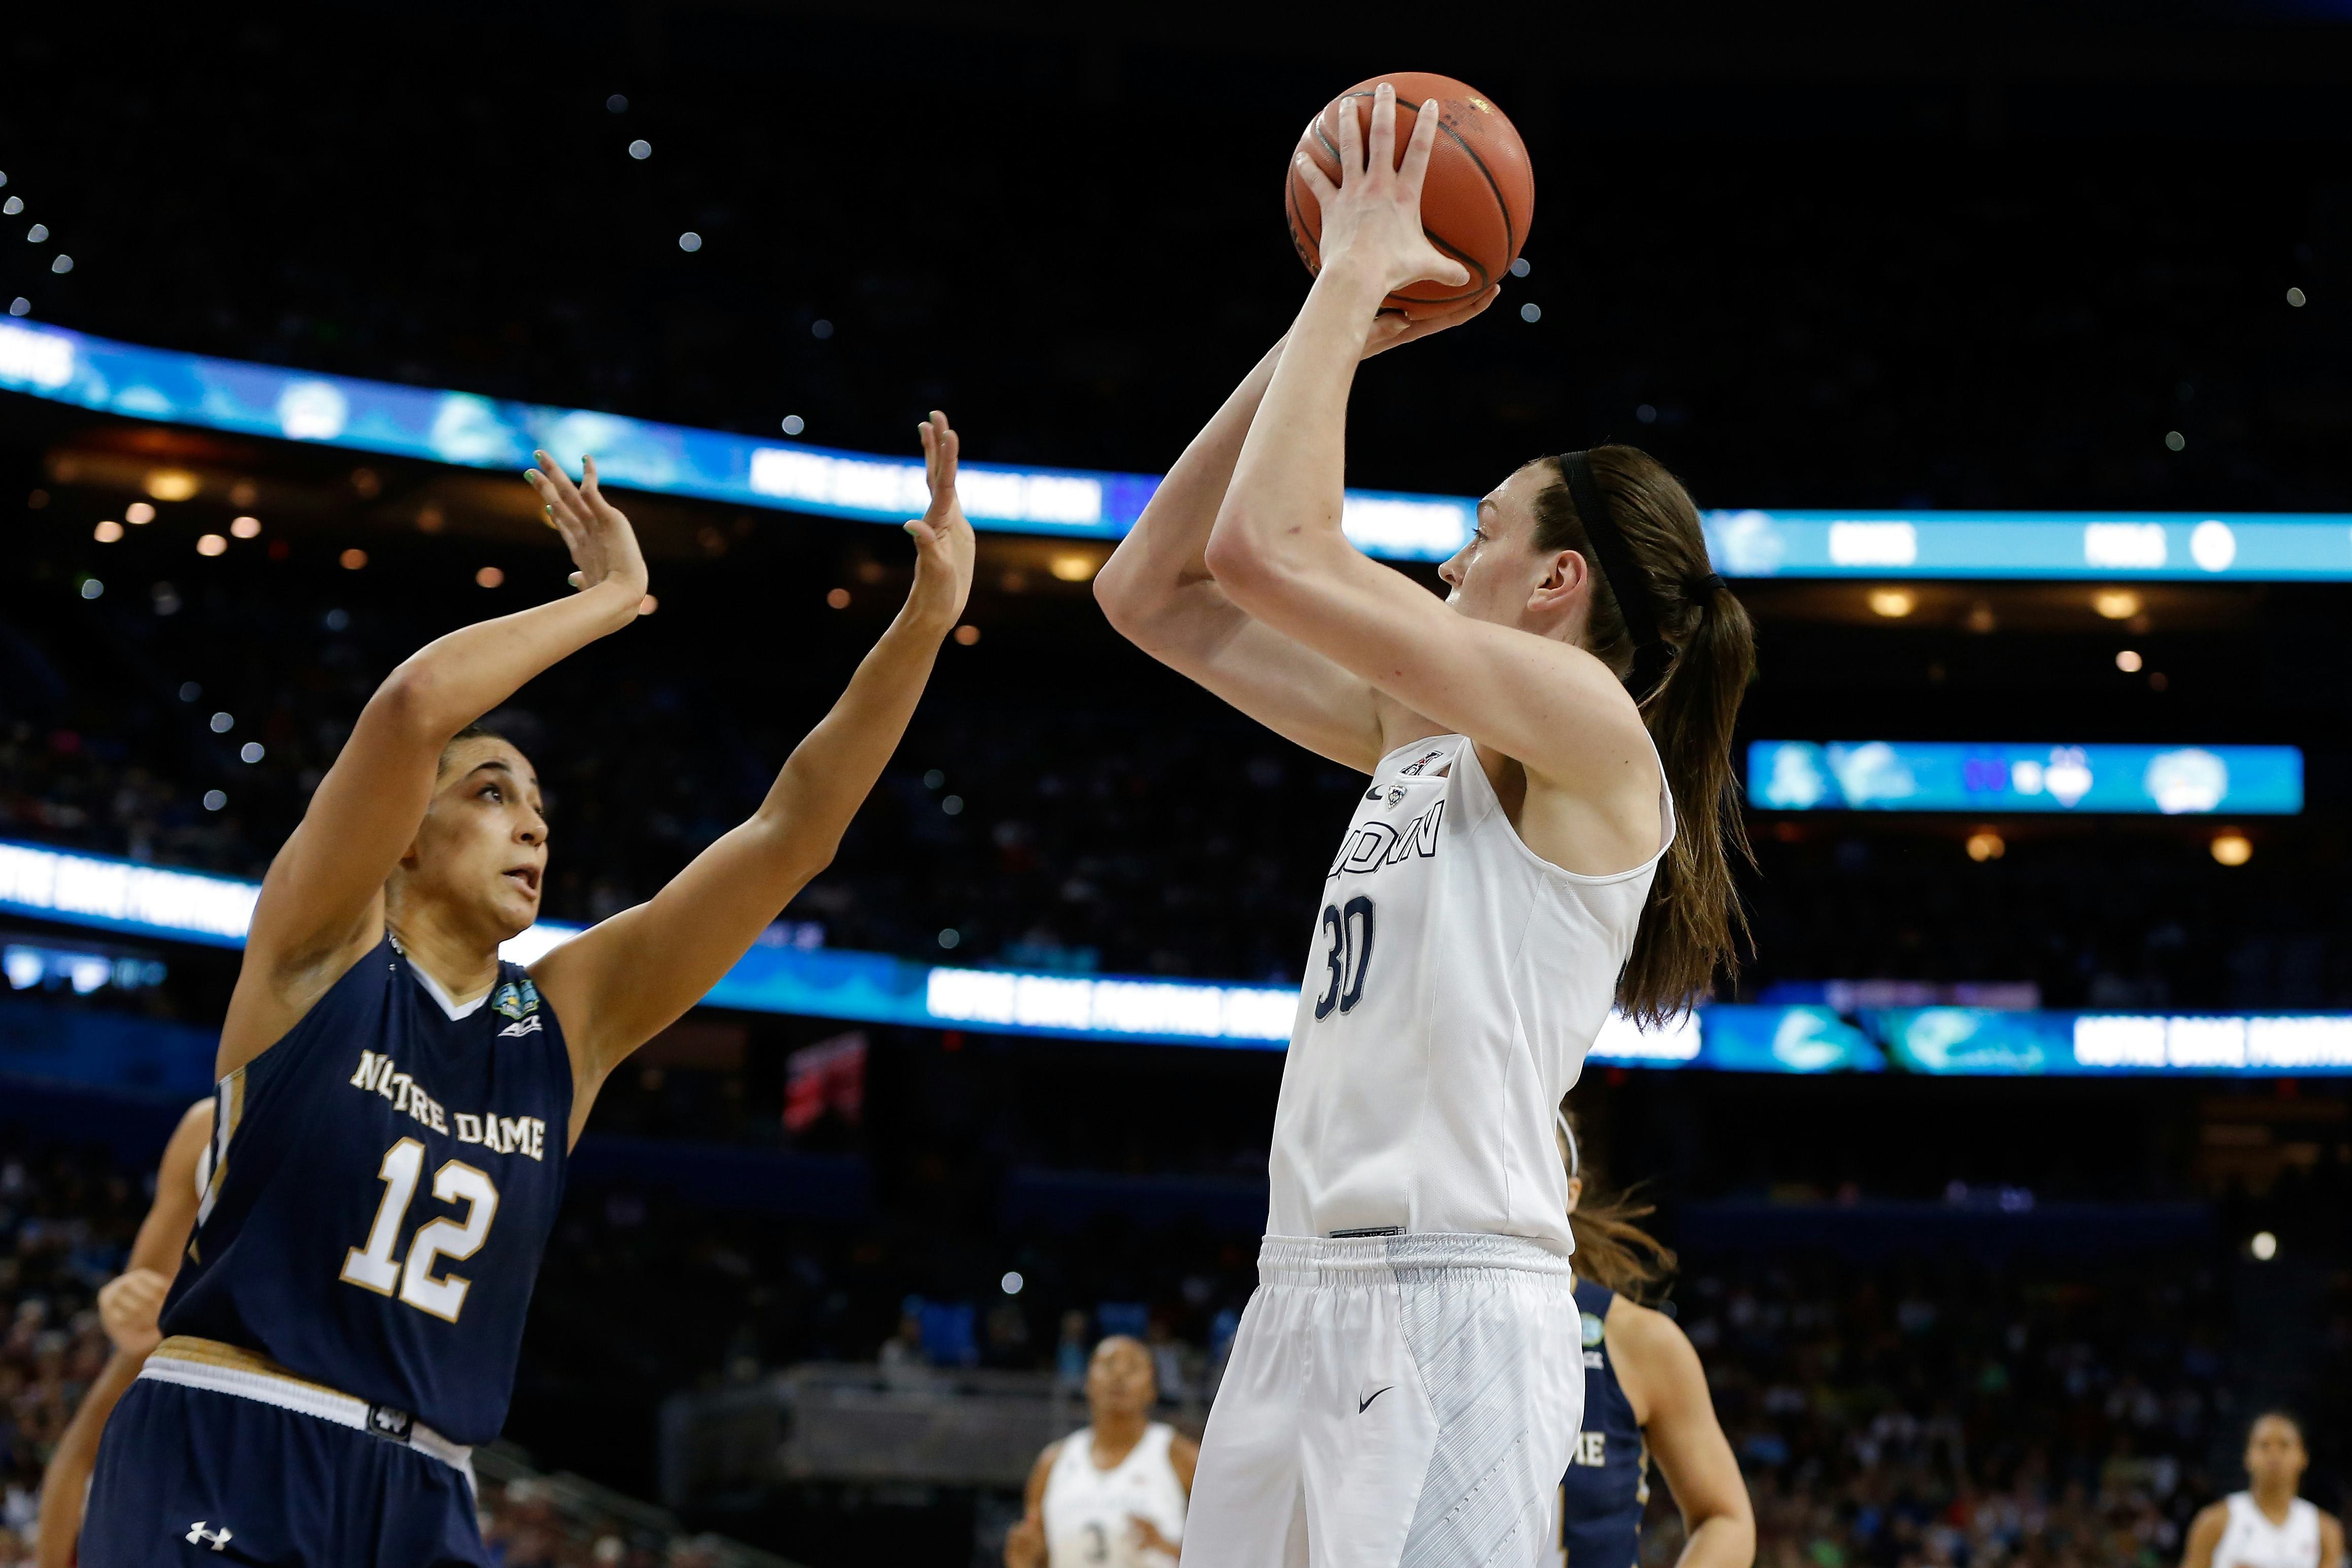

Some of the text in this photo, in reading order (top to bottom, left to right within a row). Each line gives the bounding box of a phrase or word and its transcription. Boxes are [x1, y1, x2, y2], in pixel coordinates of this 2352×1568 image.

[1315, 895, 1376, 1023] 30
[453, 1112, 545, 1161] DAME
[339, 1137, 499, 1323] 12
